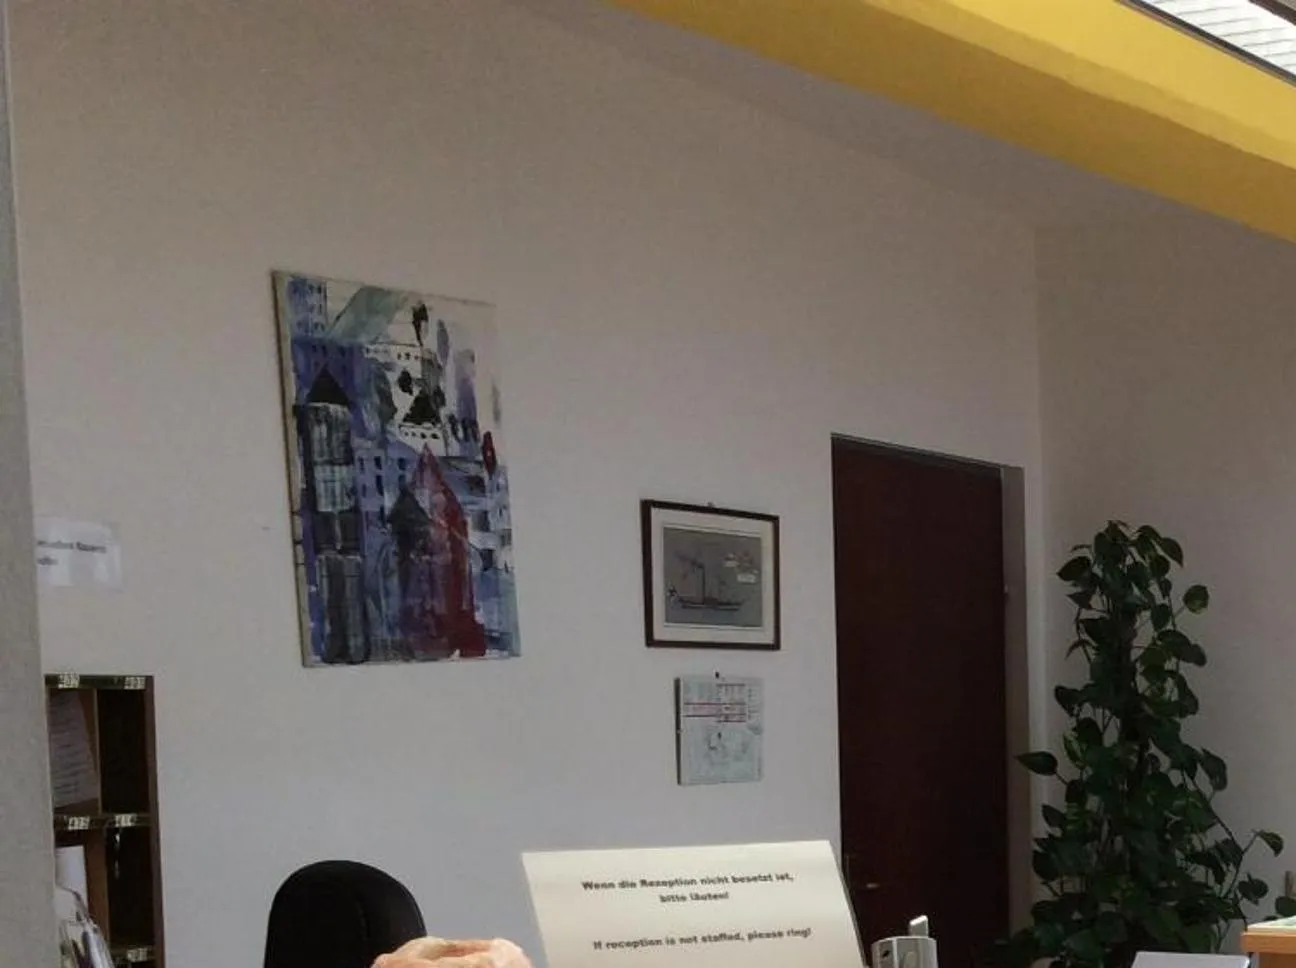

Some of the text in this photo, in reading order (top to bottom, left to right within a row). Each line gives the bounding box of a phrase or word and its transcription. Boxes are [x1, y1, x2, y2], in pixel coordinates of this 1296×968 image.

[582, 872, 794, 890] Wenn die Rezeption nicht besetzt ist,
[659, 894, 687, 902] bitte
[593, 927, 811, 949] If reception is not staffed, please ring!
